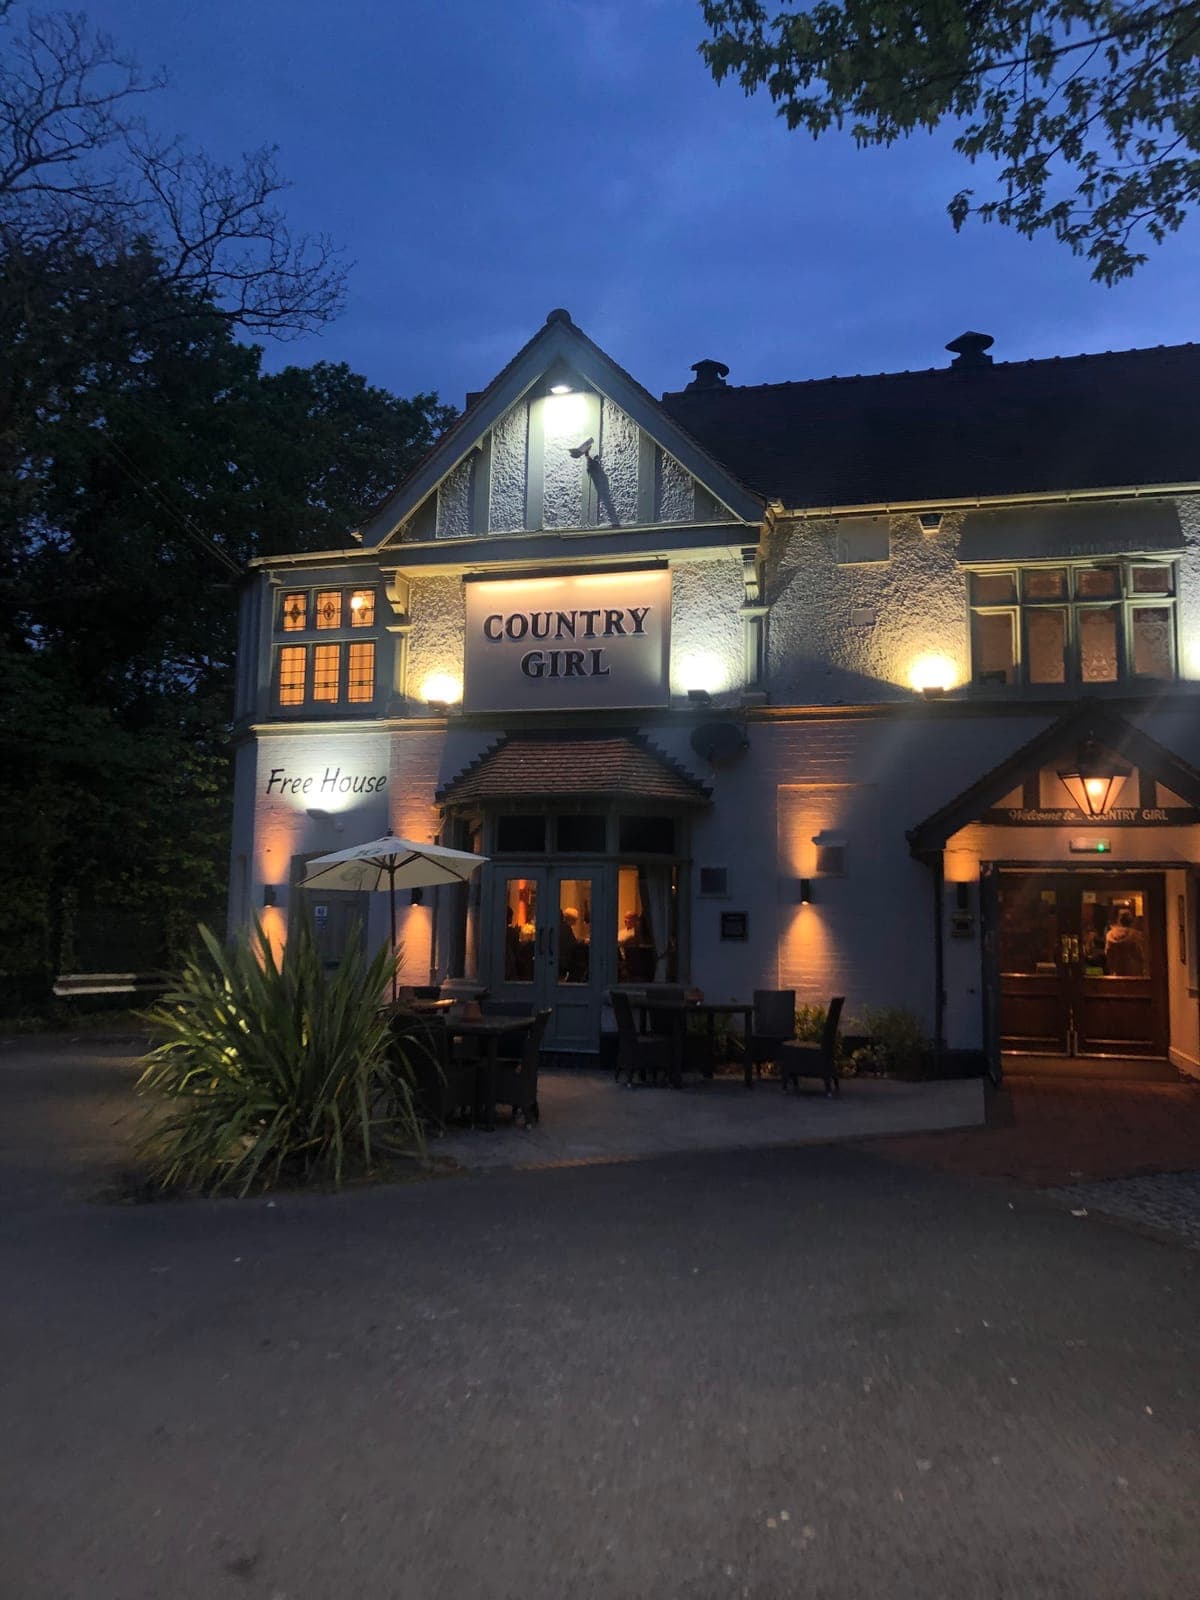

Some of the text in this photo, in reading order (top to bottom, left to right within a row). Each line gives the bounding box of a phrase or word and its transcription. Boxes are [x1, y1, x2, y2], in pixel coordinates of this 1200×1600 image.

[483, 607, 652, 641] COUNTRY
[521, 648, 610, 678] GIRL
[266, 768, 387, 794] Free House
[1142, 809, 1169, 821] GIRL
